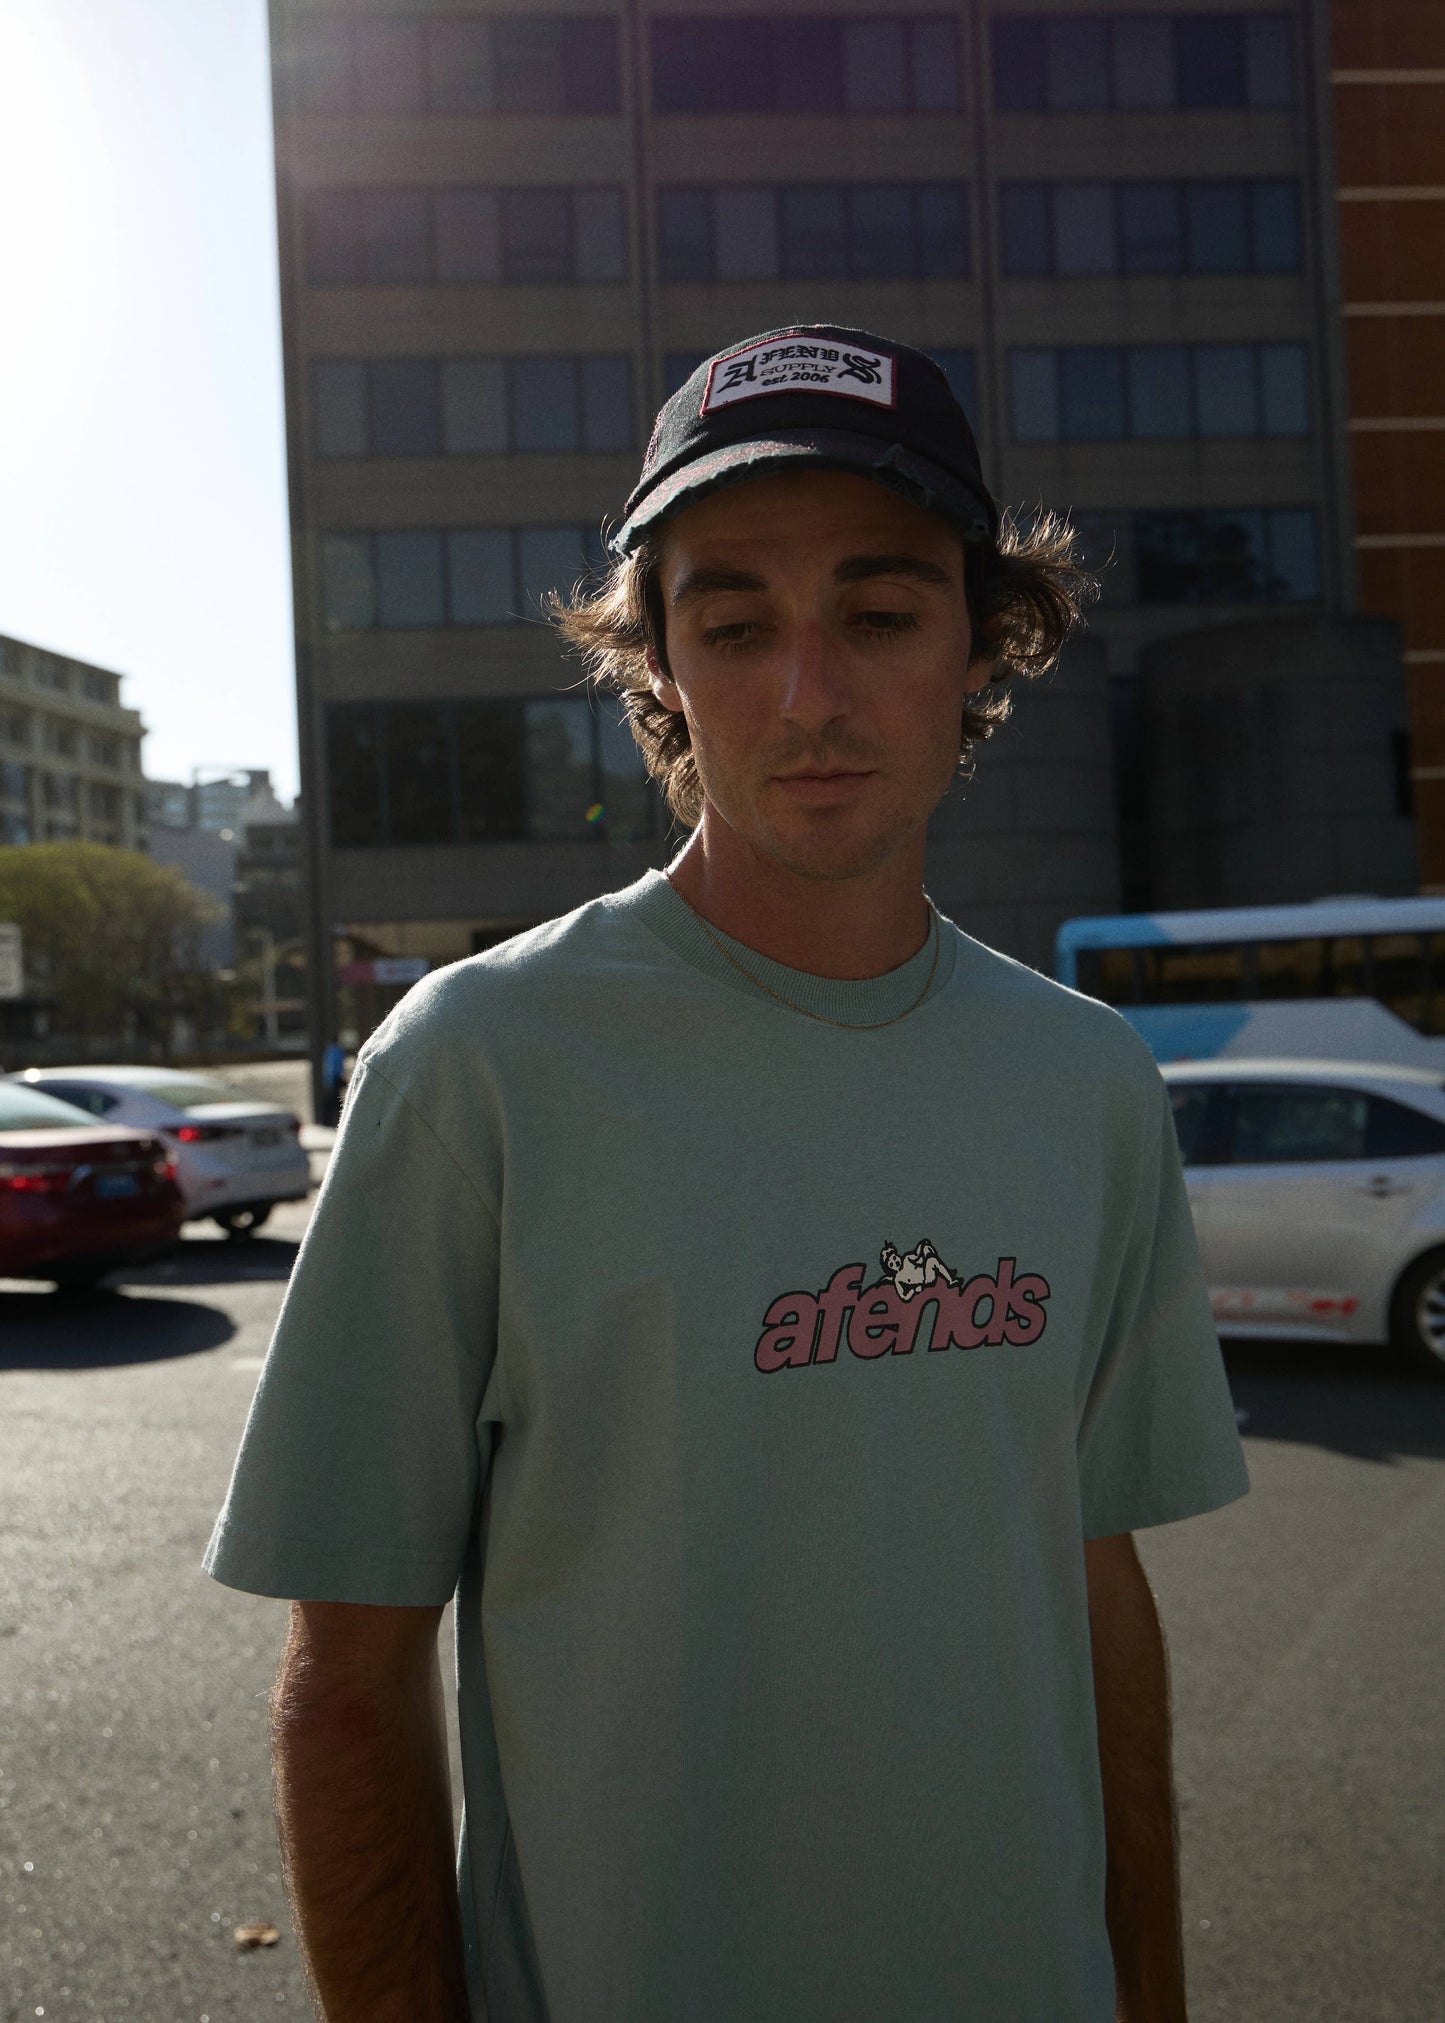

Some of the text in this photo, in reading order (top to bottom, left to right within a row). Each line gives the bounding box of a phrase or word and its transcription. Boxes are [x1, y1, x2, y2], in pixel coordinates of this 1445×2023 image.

[759, 362, 837, 377] SUPPLY
[761, 371, 830, 387] est 2006
[754, 1257, 1050, 1373] afends
